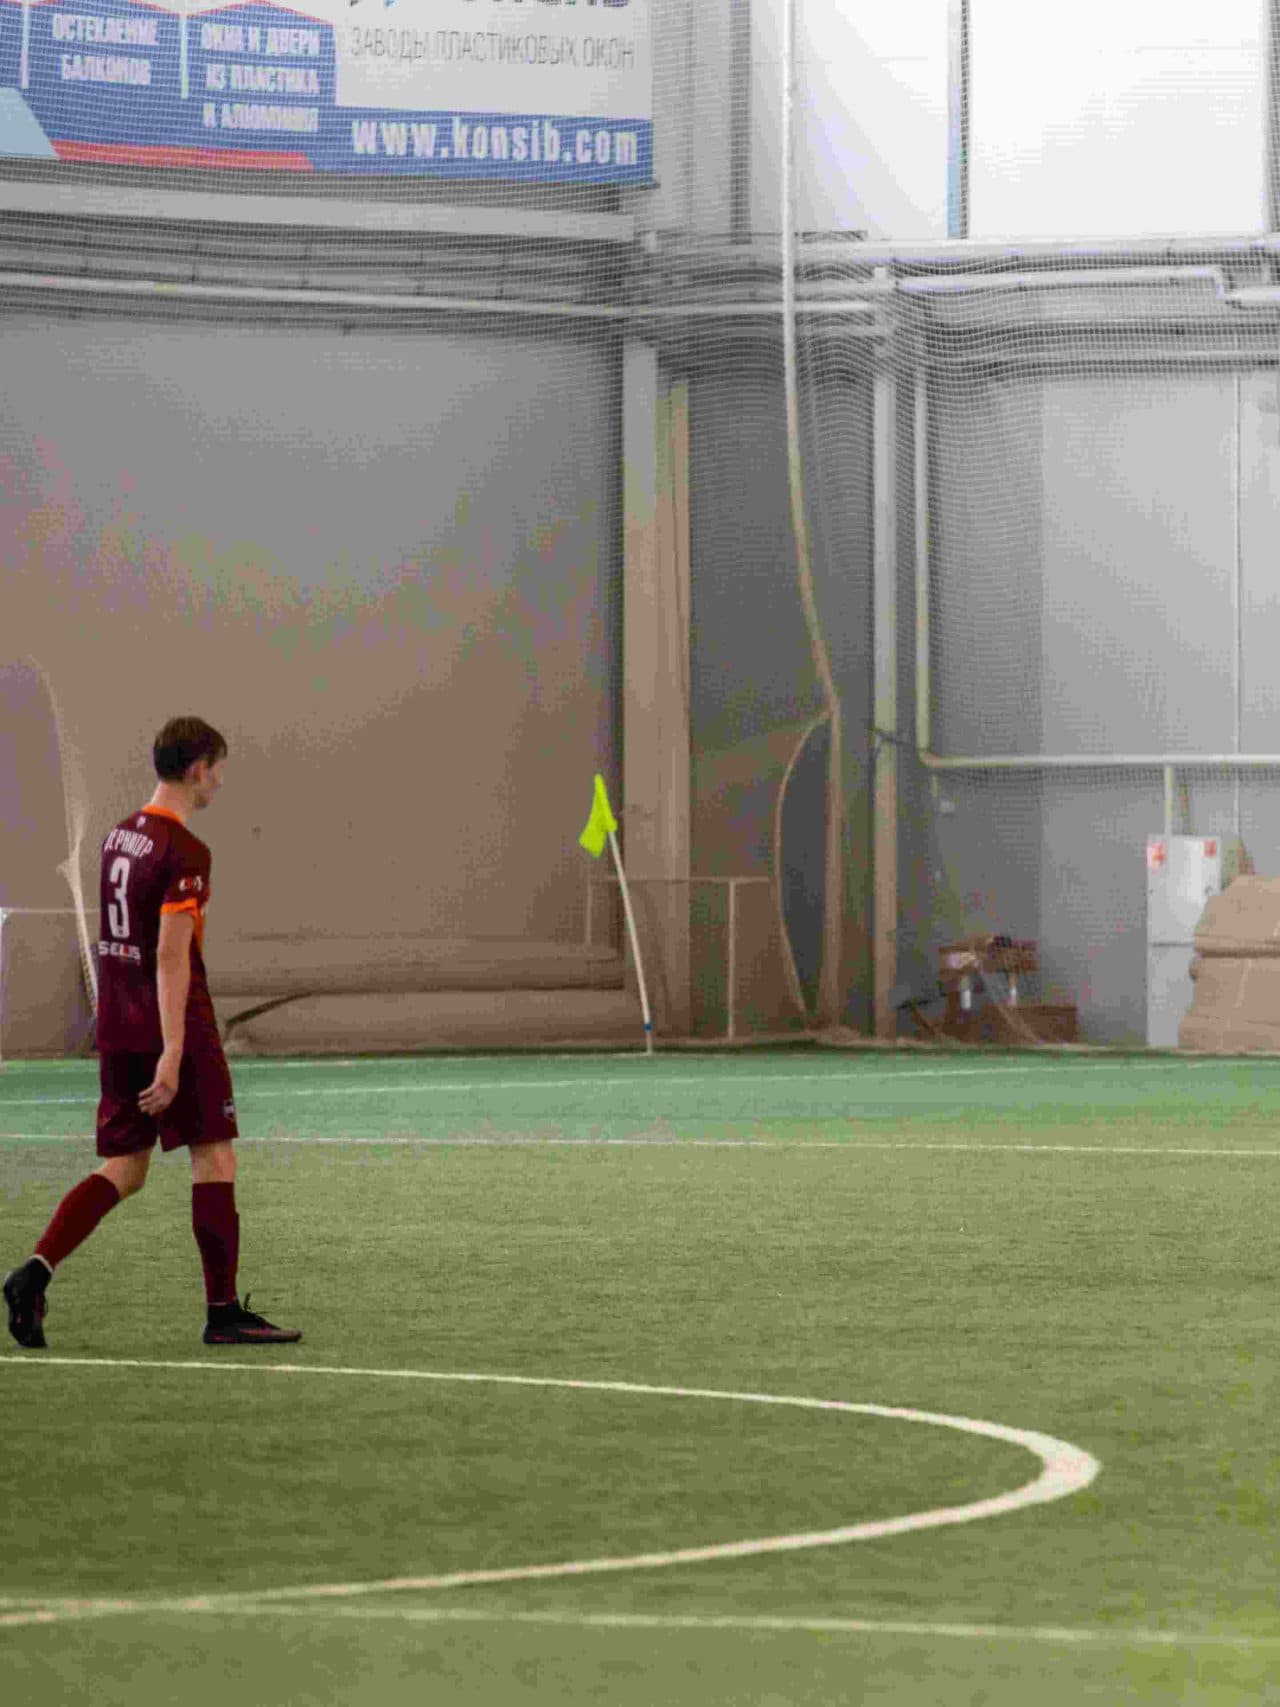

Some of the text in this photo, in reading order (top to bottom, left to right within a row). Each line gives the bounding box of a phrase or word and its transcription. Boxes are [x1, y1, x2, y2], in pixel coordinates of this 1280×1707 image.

[351, 27, 635, 70] ЗАВОДЫ ПЛАСТИКОВЫХ ОКОН
[109, 857, 130, 938] 3
